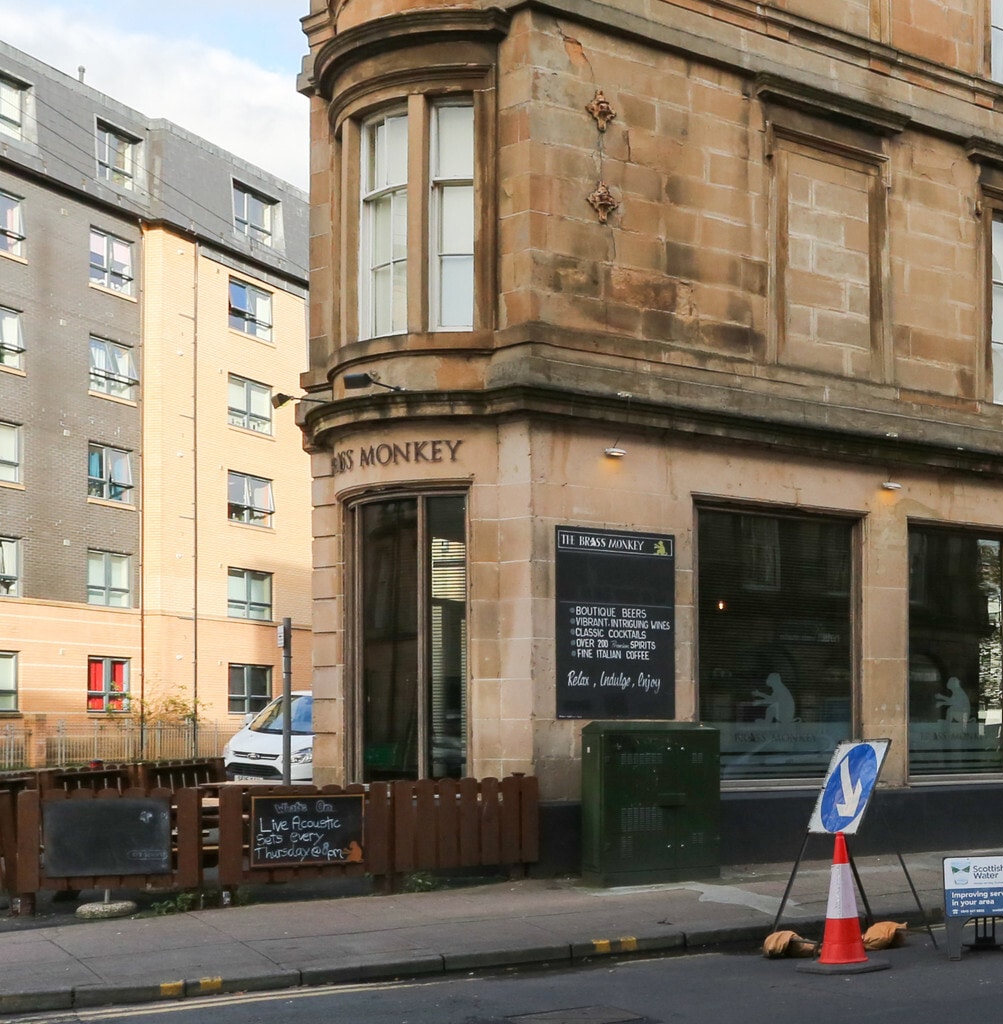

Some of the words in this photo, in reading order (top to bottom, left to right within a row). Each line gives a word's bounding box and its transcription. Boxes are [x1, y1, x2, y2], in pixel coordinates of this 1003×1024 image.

[360, 439, 463, 468] MONKEY
[579, 535, 606, 548] BRASS
[608, 538, 645, 551] MONKEY
[575, 606, 617, 617] BOUTIQUE
[621, 608, 647, 619] BEERS
[610, 618, 649, 630] INTRIGUING
[650, 620, 670, 631] WINES
[575, 627, 604, 638] CLASSIC
[608, 629, 647, 640] COCKTAILS
[576, 638, 595, 648] OVER
[597, 639, 609, 648] 200
[629, 640, 656, 650] SPIRITS
[577, 648, 593, 659] FINE
[596, 649, 622, 659] ITALIAN
[625, 651, 650, 661] COFFEE
[637, 671, 661, 694] Enjoy
[315, 799, 335, 813] On
[259, 817, 289, 833] Live
[292, 815, 341, 831] Acoustic
[256, 833, 284, 847] Sets
[290, 831, 325, 846] every
[973, 871, 999, 880] Water
[951, 890, 989, 900] Improving
[951, 899, 959, 907] in
[960, 900, 977, 908] your
[978, 898, 995, 906] area
